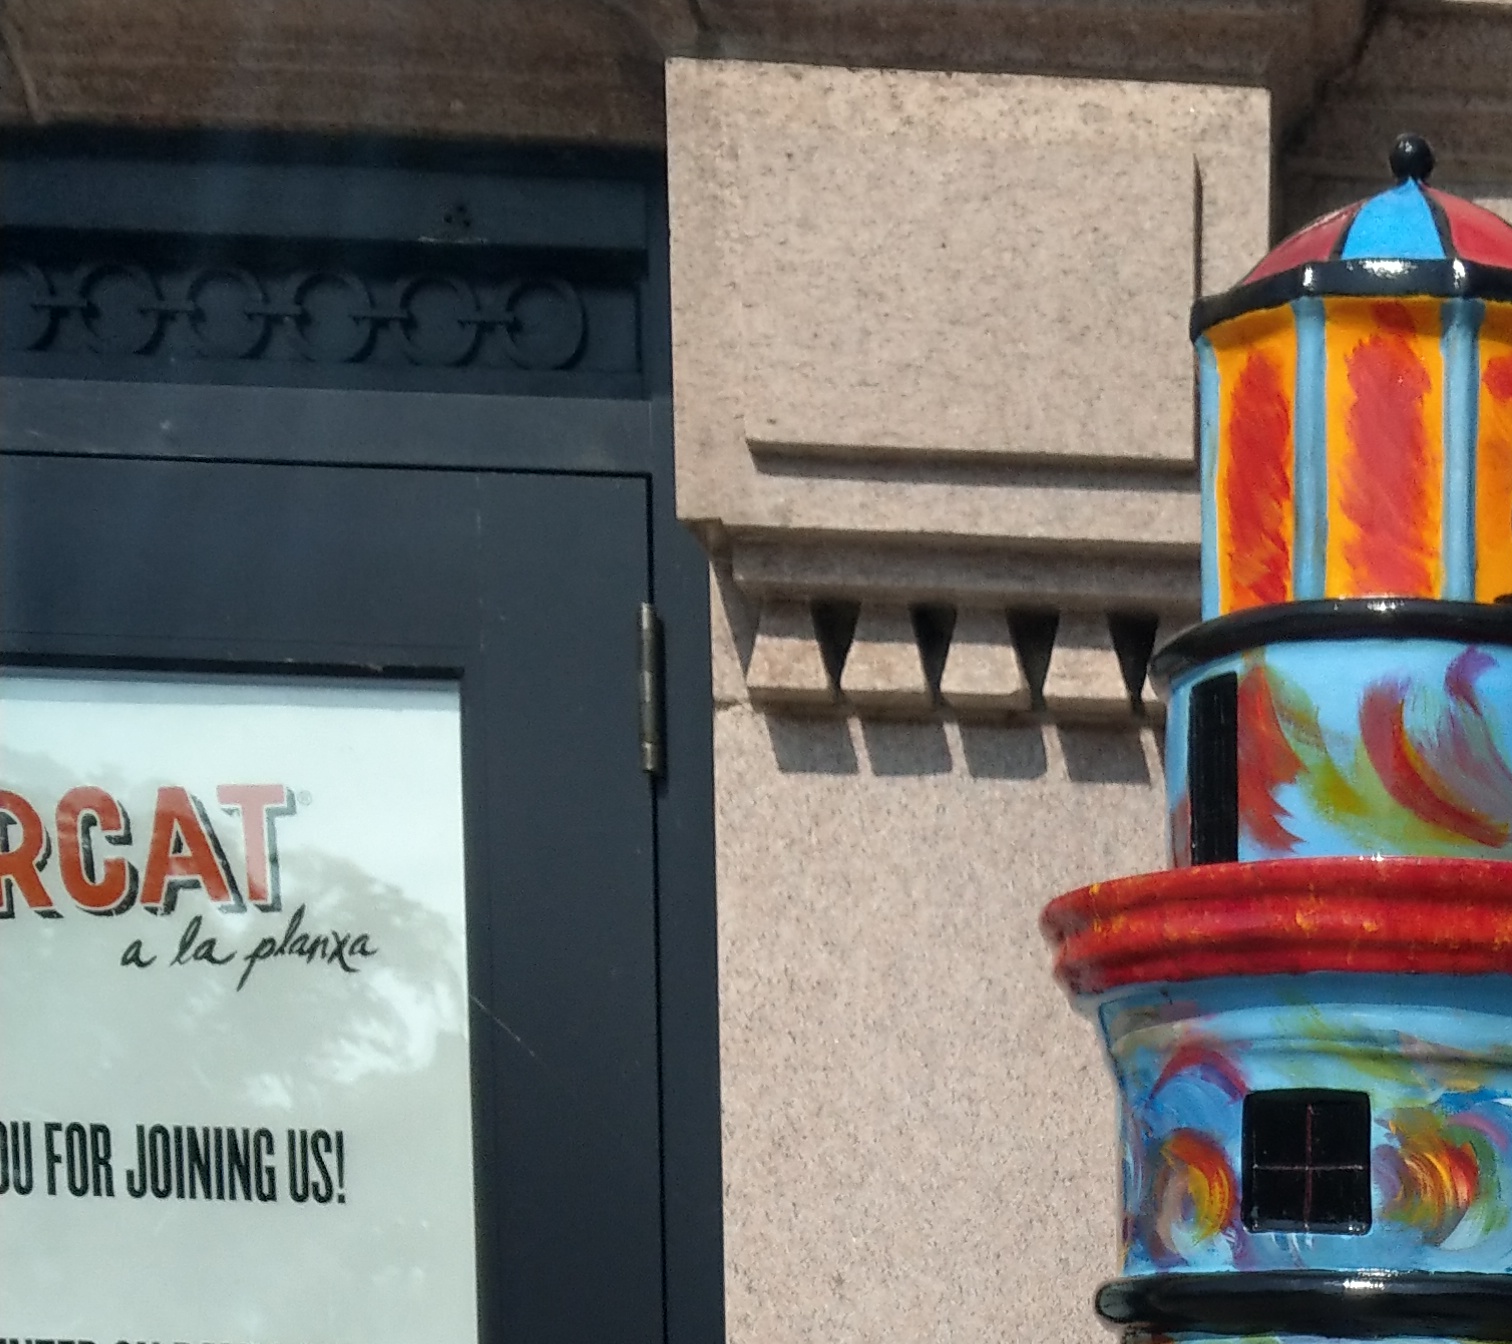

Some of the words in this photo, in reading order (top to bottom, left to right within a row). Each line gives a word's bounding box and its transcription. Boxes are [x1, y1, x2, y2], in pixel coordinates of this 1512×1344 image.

[121, 939, 157, 967] a
[169, 916, 237, 967] la
[237, 904, 377, 991] planxa
[44, 1121, 115, 1197] FOR
[126, 1124, 278, 1202] JOINING
[287, 1129, 346, 1204] US!
